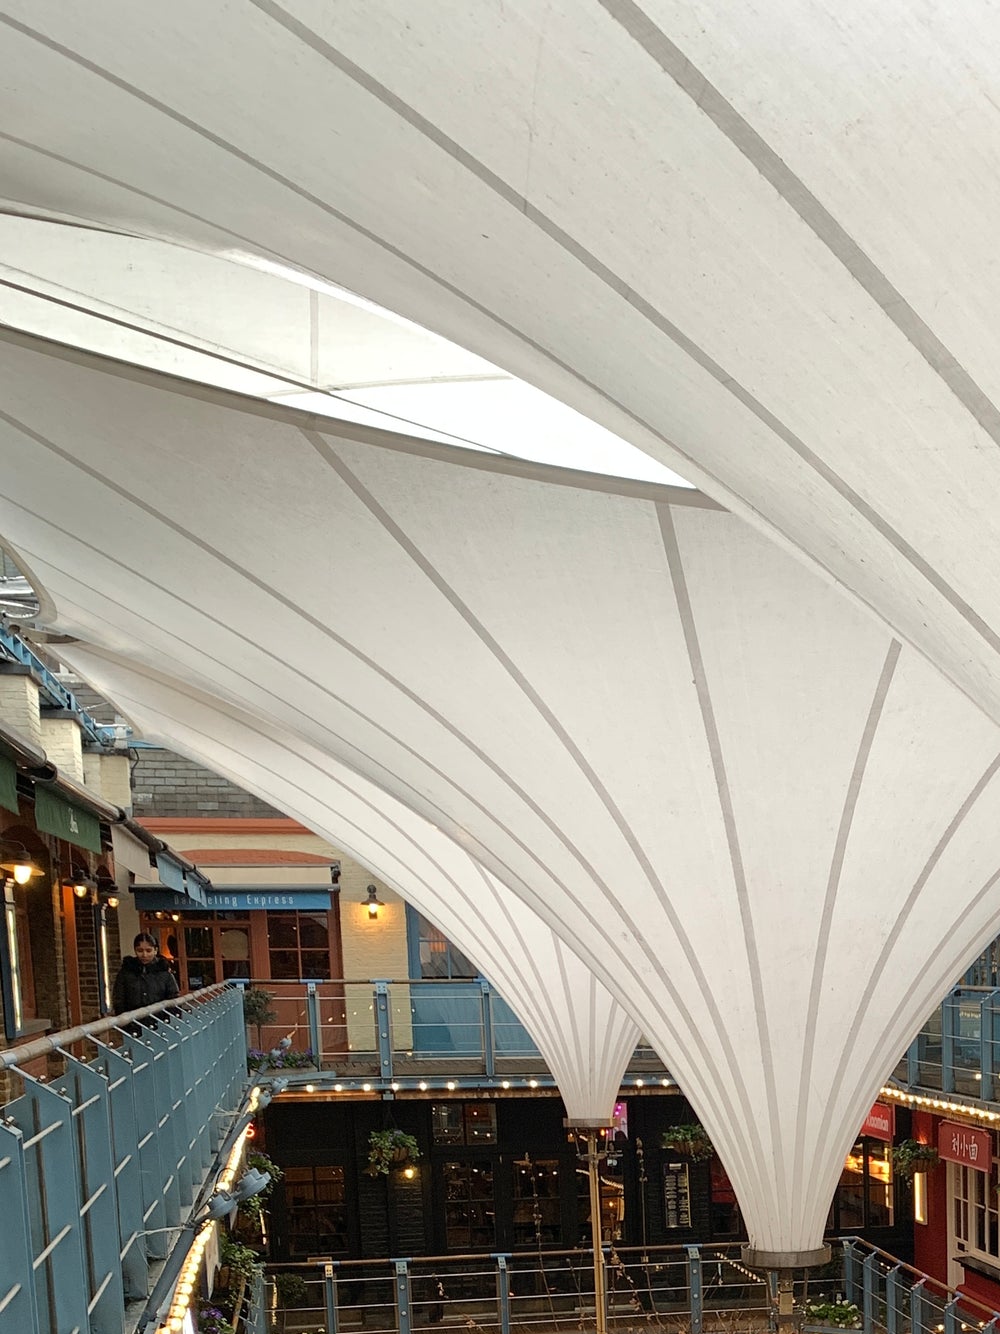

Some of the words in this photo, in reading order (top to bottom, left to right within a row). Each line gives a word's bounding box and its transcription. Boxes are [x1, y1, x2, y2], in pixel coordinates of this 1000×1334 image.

[246, 894, 295, 905] Express
[951, 1132, 978, 1162] 刘小面
